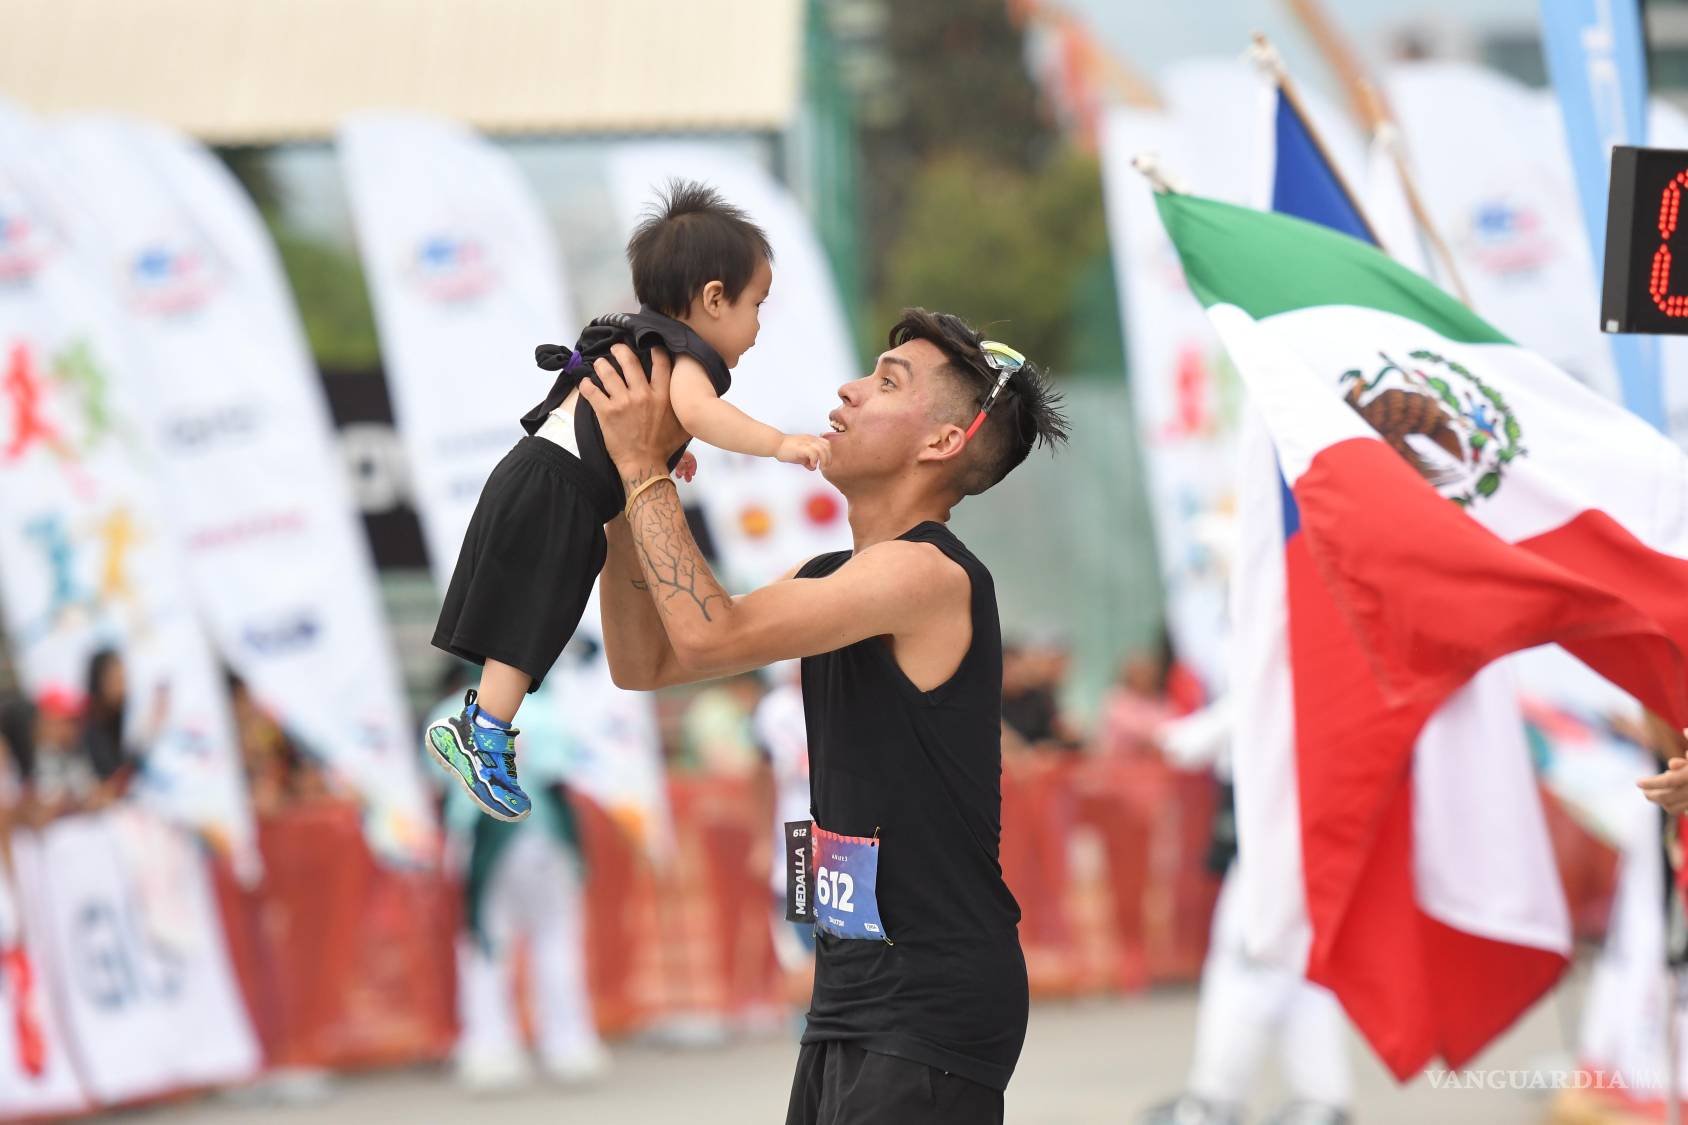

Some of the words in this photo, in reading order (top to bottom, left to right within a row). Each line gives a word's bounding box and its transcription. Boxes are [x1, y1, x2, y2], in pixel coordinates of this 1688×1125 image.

[793, 828, 807, 838] 612
[795, 847, 806, 915] MEDALLA
[817, 866, 854, 913] 612
